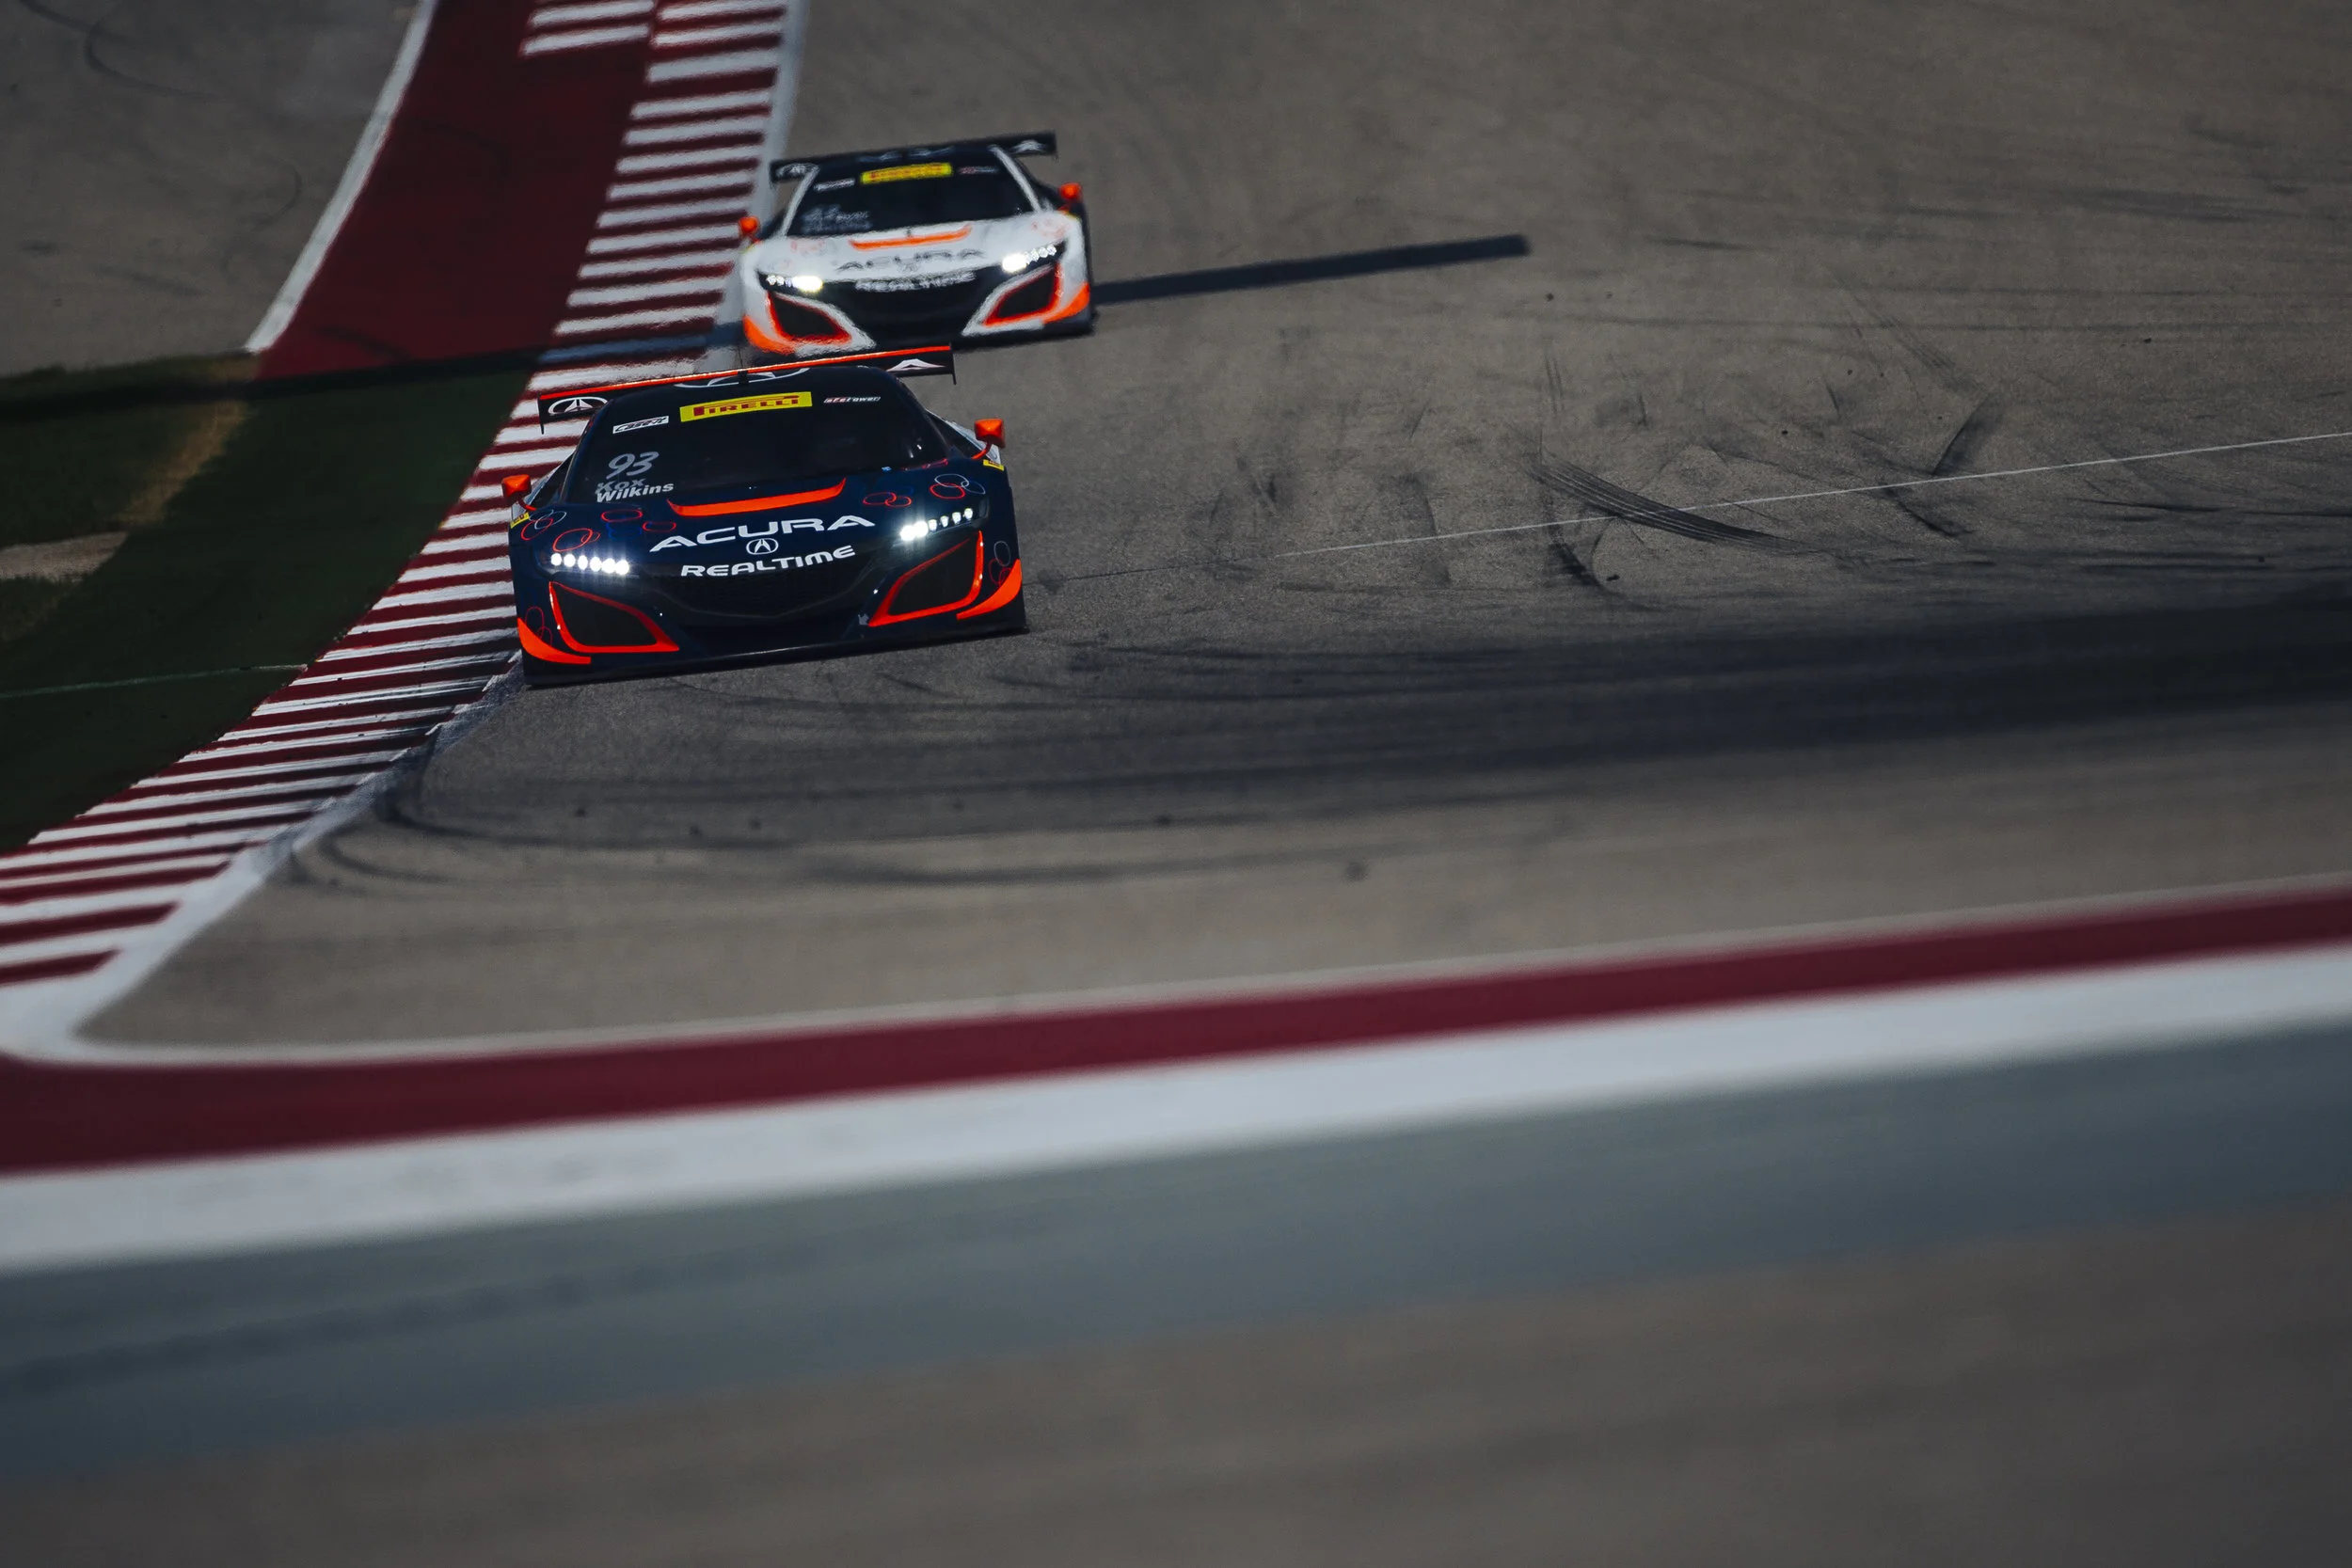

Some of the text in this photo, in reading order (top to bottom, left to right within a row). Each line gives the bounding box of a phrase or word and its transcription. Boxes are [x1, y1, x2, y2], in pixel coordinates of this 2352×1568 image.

[692, 394, 800, 417] PIRELLI
[607, 451, 659, 479] 93
[596, 478, 645, 494] Kox
[596, 482, 674, 502] Wilkins
[649, 515, 876, 552] ACURA
[681, 545, 856, 577] REALTIME
